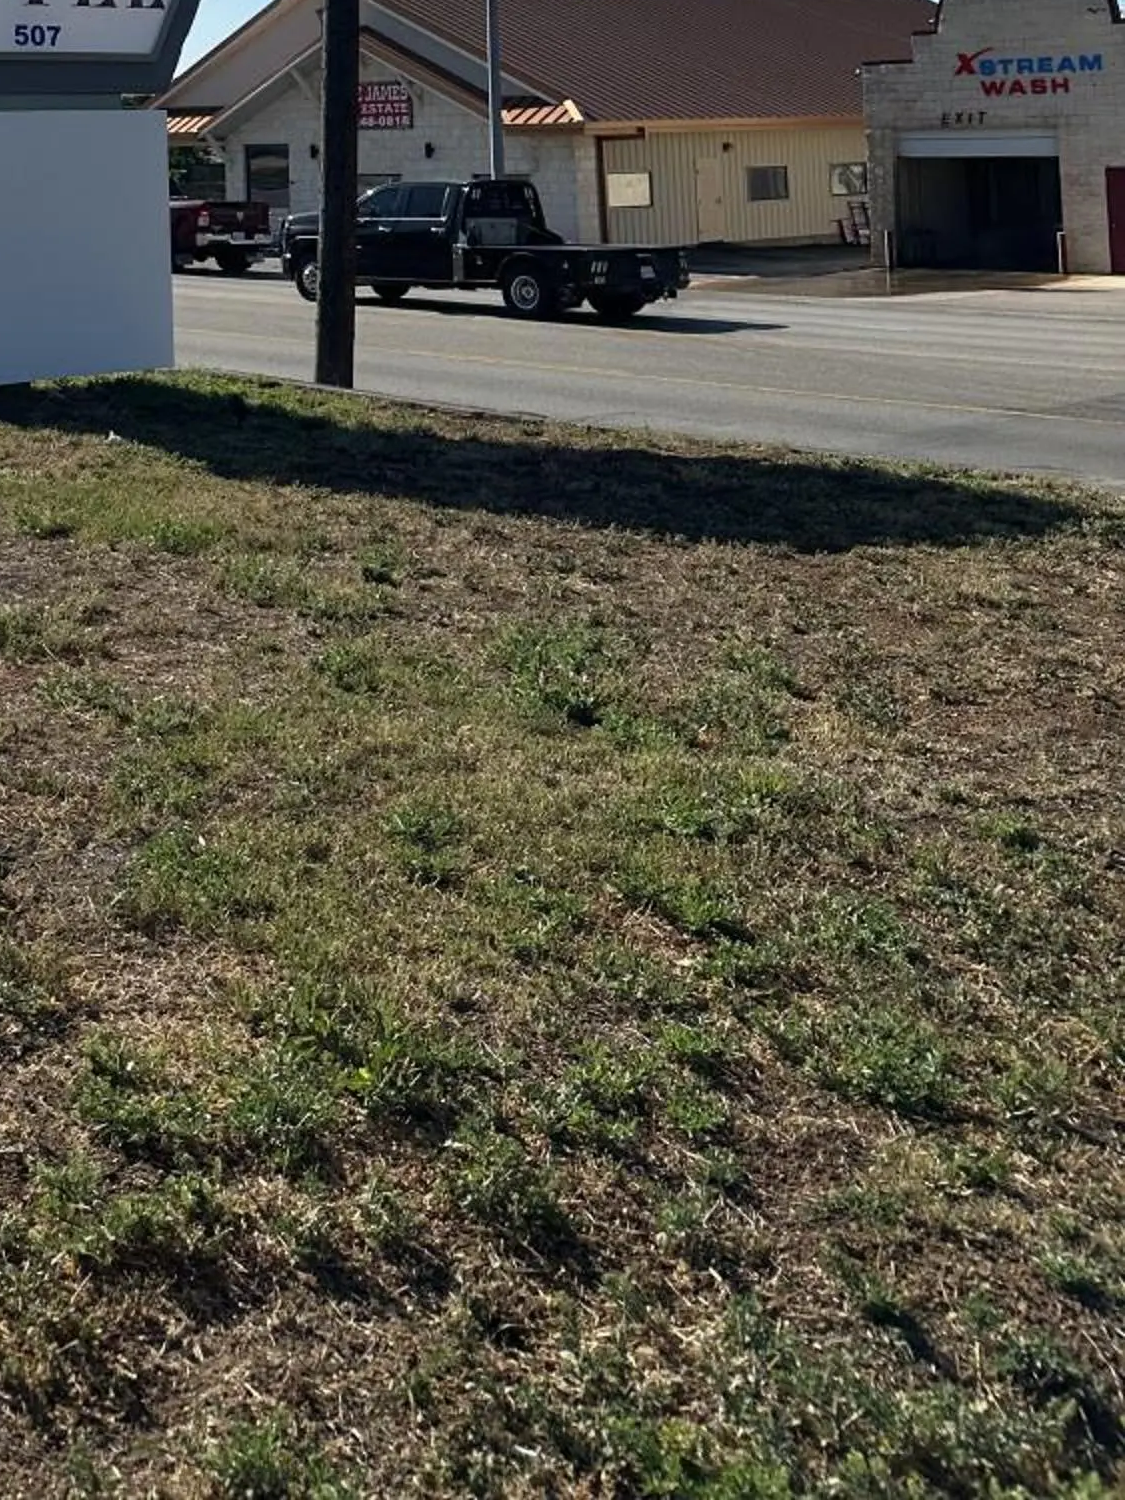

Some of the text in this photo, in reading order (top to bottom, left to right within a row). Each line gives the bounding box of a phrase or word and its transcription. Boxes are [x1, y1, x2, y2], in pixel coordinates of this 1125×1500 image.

[14, 24, 62, 47] 507
[954, 46, 1103, 77] XSTREAM
[364, 85, 409, 102] JAMES
[980, 77, 1070, 98] WASH
[360, 103, 410, 115] ESTATE
[941, 111, 988, 129] EXIT
